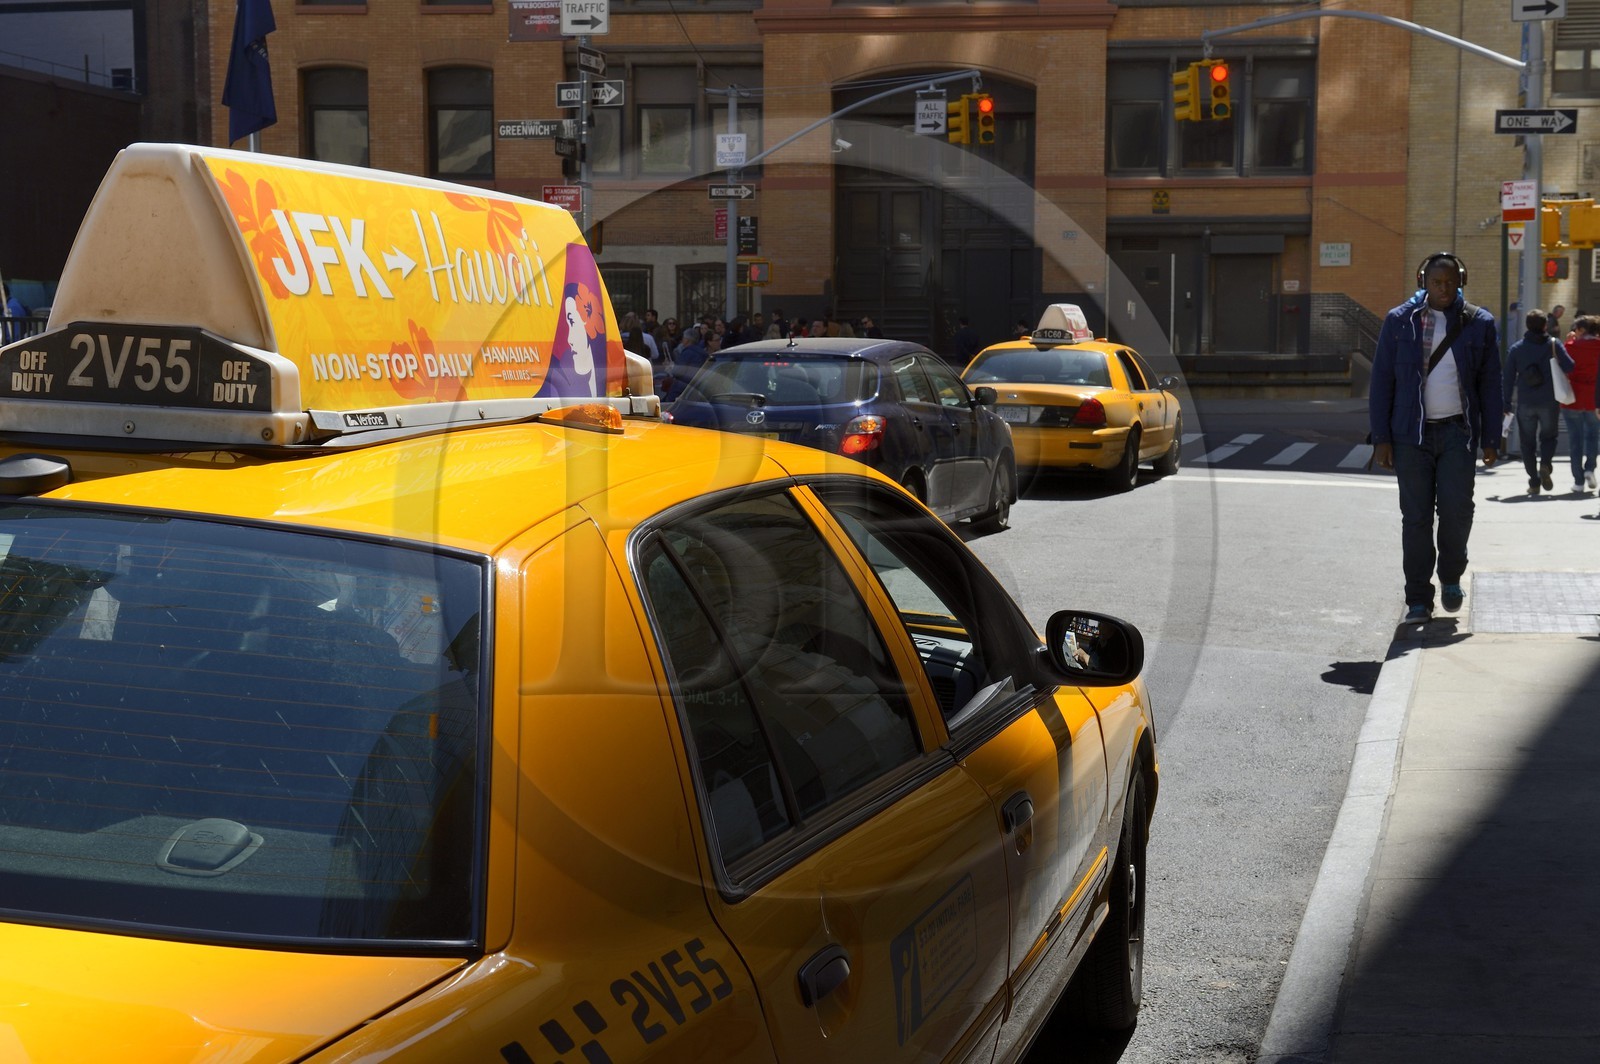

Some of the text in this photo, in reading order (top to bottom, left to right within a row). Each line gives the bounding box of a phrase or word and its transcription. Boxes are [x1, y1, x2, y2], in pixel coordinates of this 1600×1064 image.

[565, 3, 605, 13] TRAFFIC
[566, 88, 613, 99] ON WAY
[918, 112, 944, 120] TRAFFIC
[924, 103, 938, 111] ALL
[500, 125, 550, 136] GREENWICH
[1507, 117, 1565, 127] ONE WAY
[271, 209, 394, 299] JFK
[1044, 330, 1061, 338] 1C60
[20, 350, 48, 370] OFF
[67, 333, 192, 394] 2V55
[481, 345, 540, 364] HAWAIIAN
[221, 361, 250, 381] OFF
[310, 352, 475, 381] NON-STOP DAILY
[501, 369, 531, 381] AIRLINES
[11, 372, 53, 393] DUTY
[213, 382, 258, 404] DUTY
[683, 690, 714, 705] DIAL
[936, 902, 957, 929] INITIAL
[957, 886, 972, 912] FARE
[610, 937, 733, 1044] 2V55
